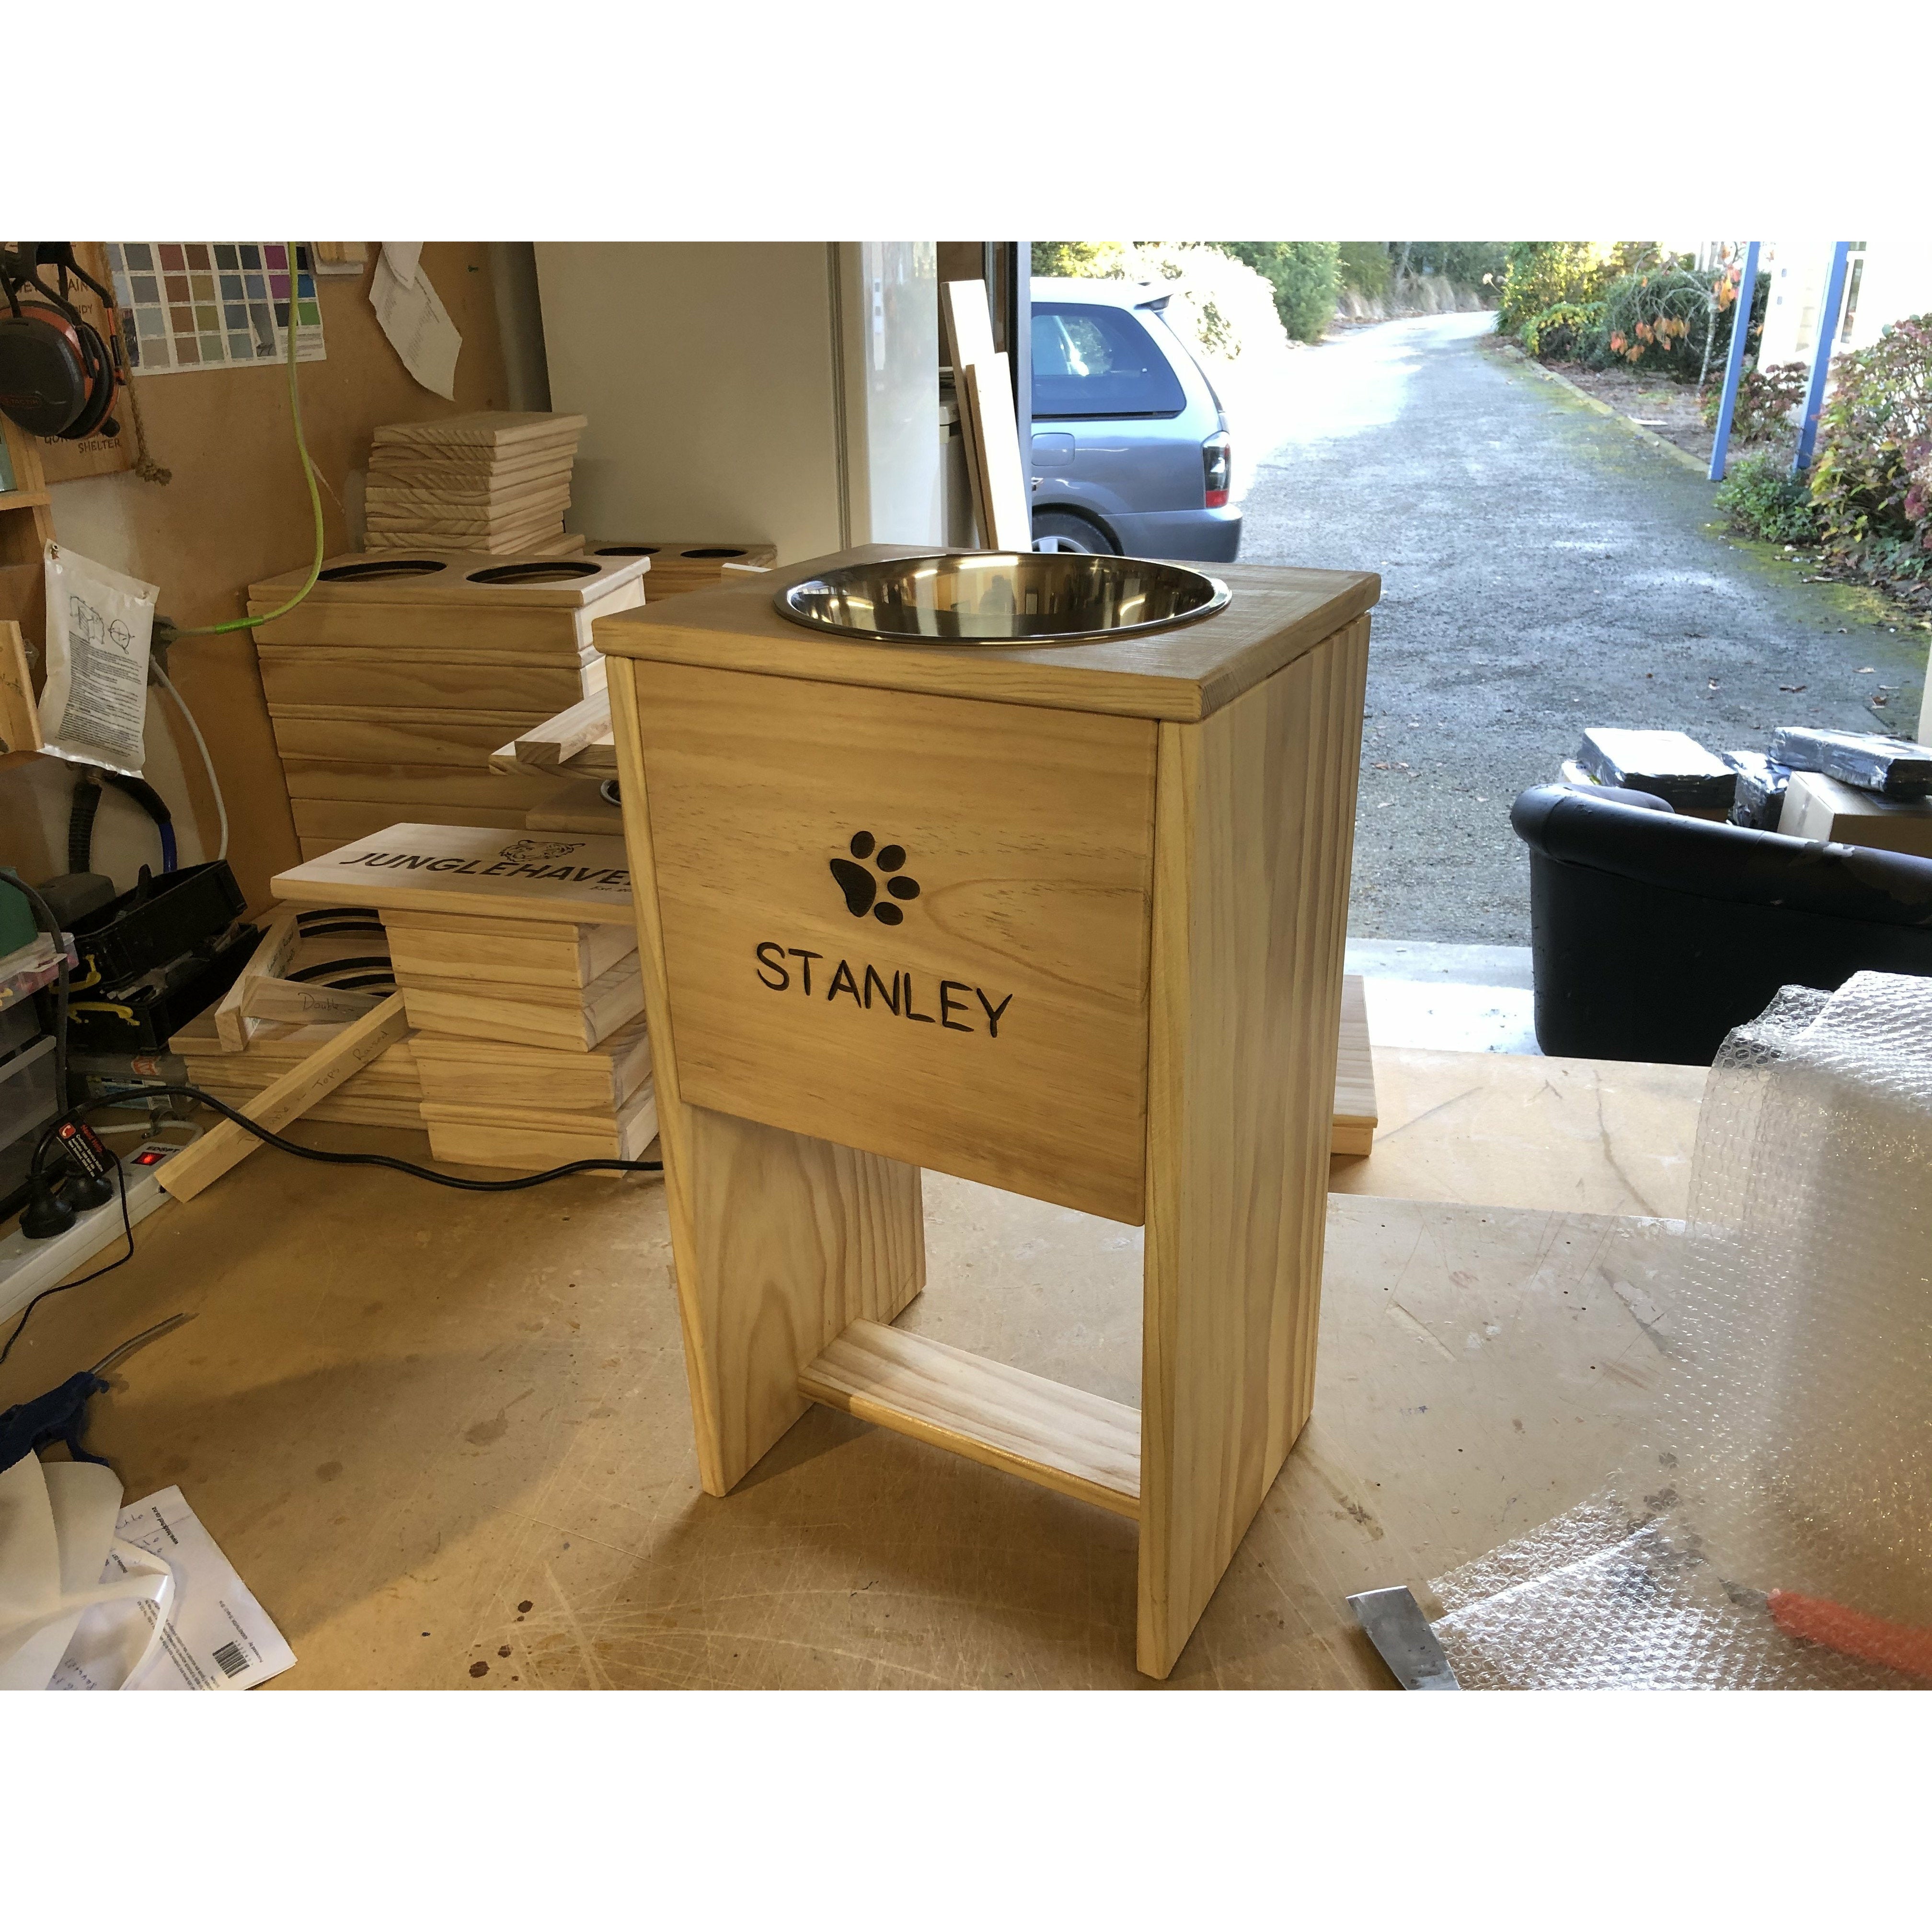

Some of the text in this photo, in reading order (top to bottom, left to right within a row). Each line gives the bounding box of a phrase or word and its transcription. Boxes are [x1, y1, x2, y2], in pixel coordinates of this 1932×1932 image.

[78, 438, 121, 454] SHELTER
[339, 853, 631, 886] JUNGLEHAVE
[298, 992, 339, 1012] Double
[757, 942, 1012, 1037] STANLEY
